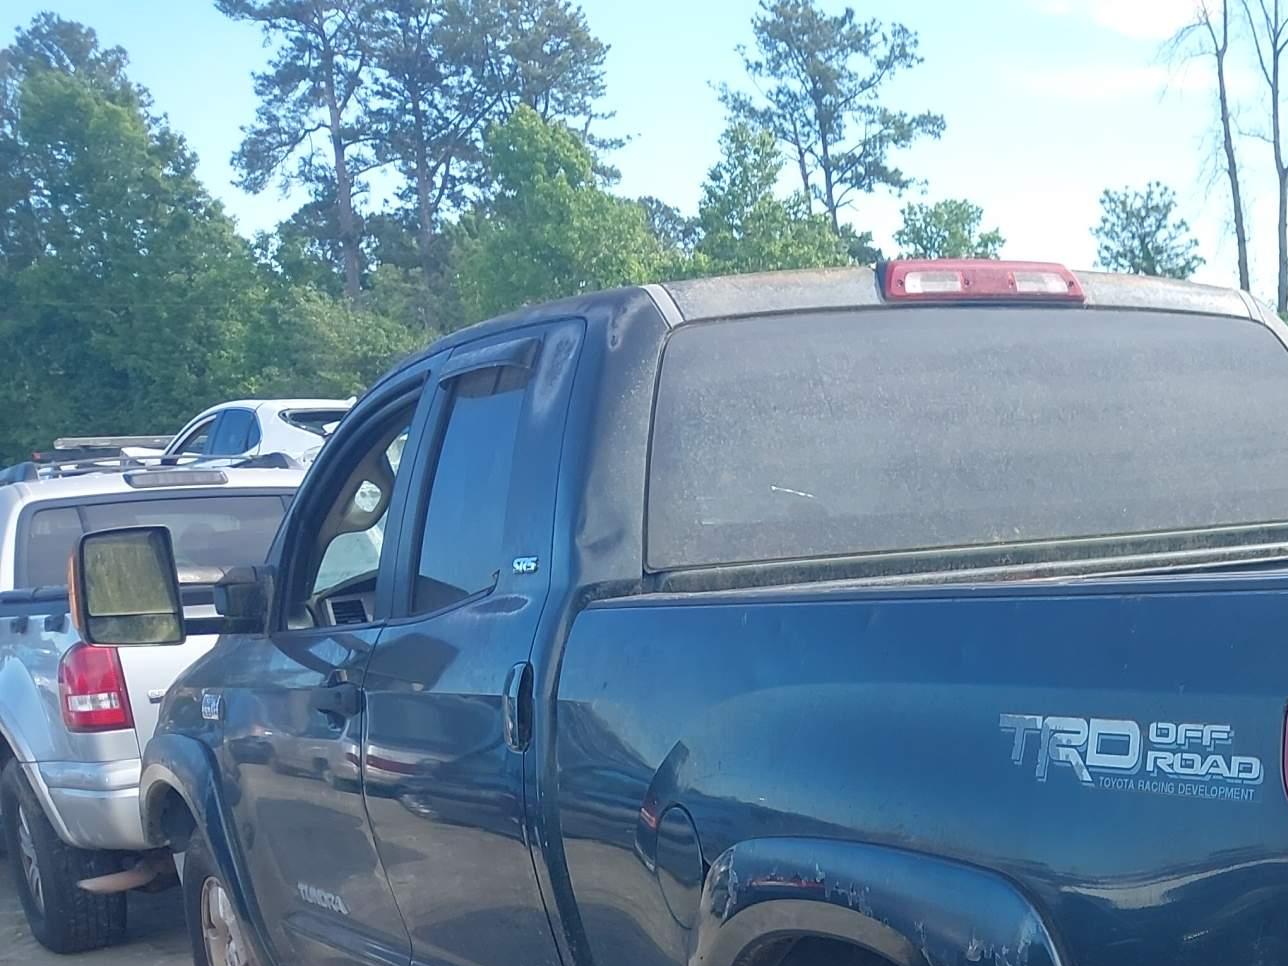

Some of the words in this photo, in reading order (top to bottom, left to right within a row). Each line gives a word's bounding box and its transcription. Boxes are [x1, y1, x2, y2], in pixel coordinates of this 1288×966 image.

[1000, 713, 1143, 786] TRD
[1148, 721, 1234, 756] OFF
[1146, 750, 1264, 785] ROAD
[1099, 775, 1136, 791] TOYOTA
[1137, 779, 1176, 796] RACING
[1177, 782, 1256, 802] DEVELOPMENT
[297, 880, 350, 915] TUNDRA
